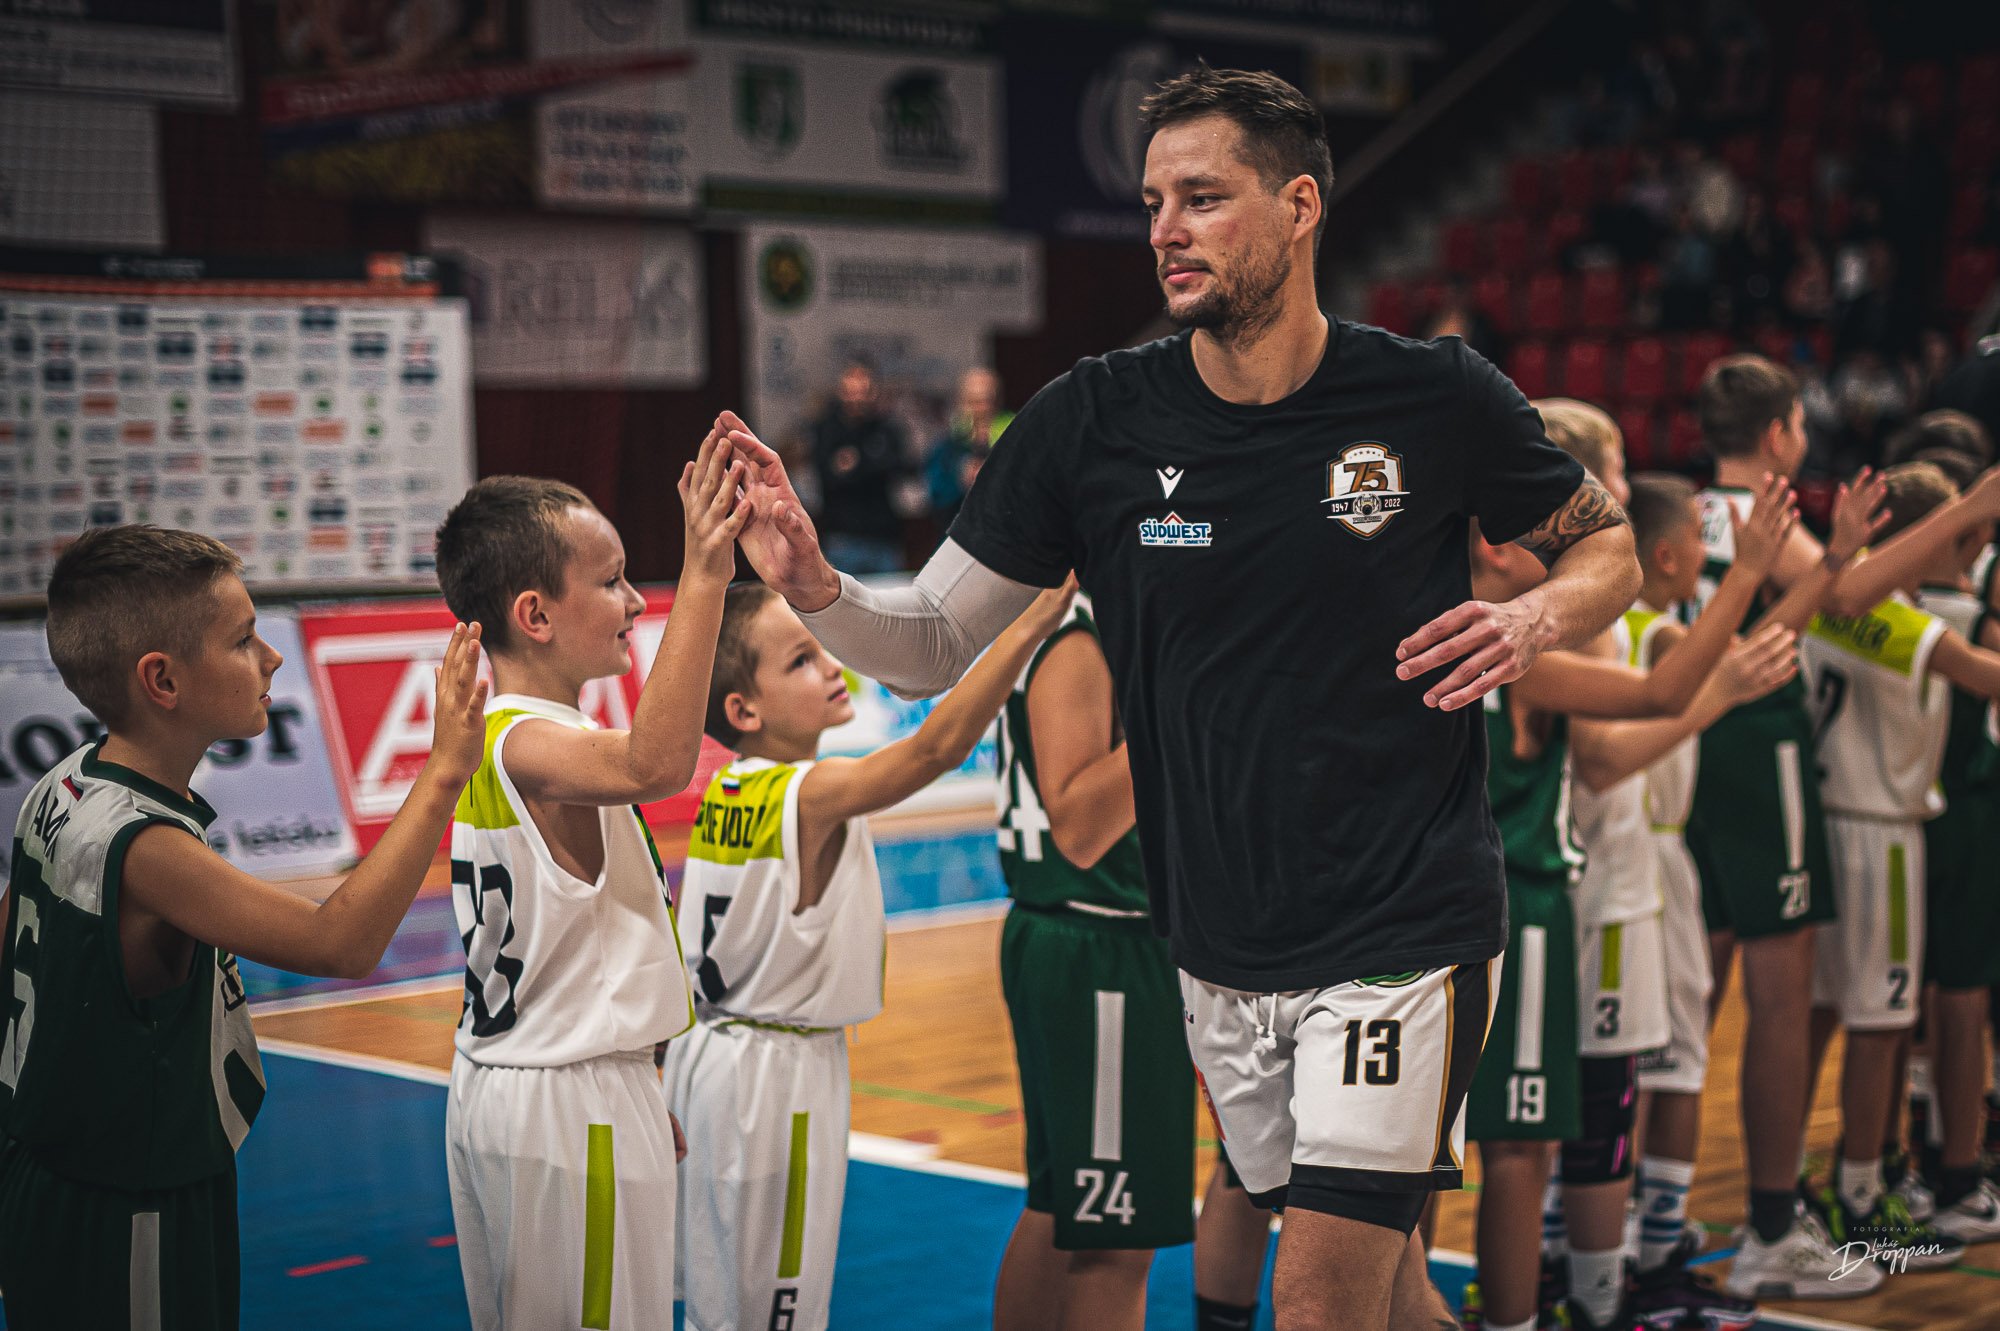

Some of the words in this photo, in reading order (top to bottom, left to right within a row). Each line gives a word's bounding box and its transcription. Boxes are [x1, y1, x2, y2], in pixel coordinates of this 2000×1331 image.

[1343, 461, 1388, 493] 75
[1331, 502, 1349, 513] 1947
[1384, 498, 1401, 508] 2022
[1140, 520, 1210, 538] SÜDWEST
[1778, 870, 1811, 920] 21
[1887, 967, 1909, 1011] 2
[1596, 997, 1620, 1038] 3
[1342, 1018, 1402, 1086] 13
[1506, 1073, 1547, 1123] 19
[1073, 1168, 1136, 1225] 24
[767, 1286, 798, 1331] 6
